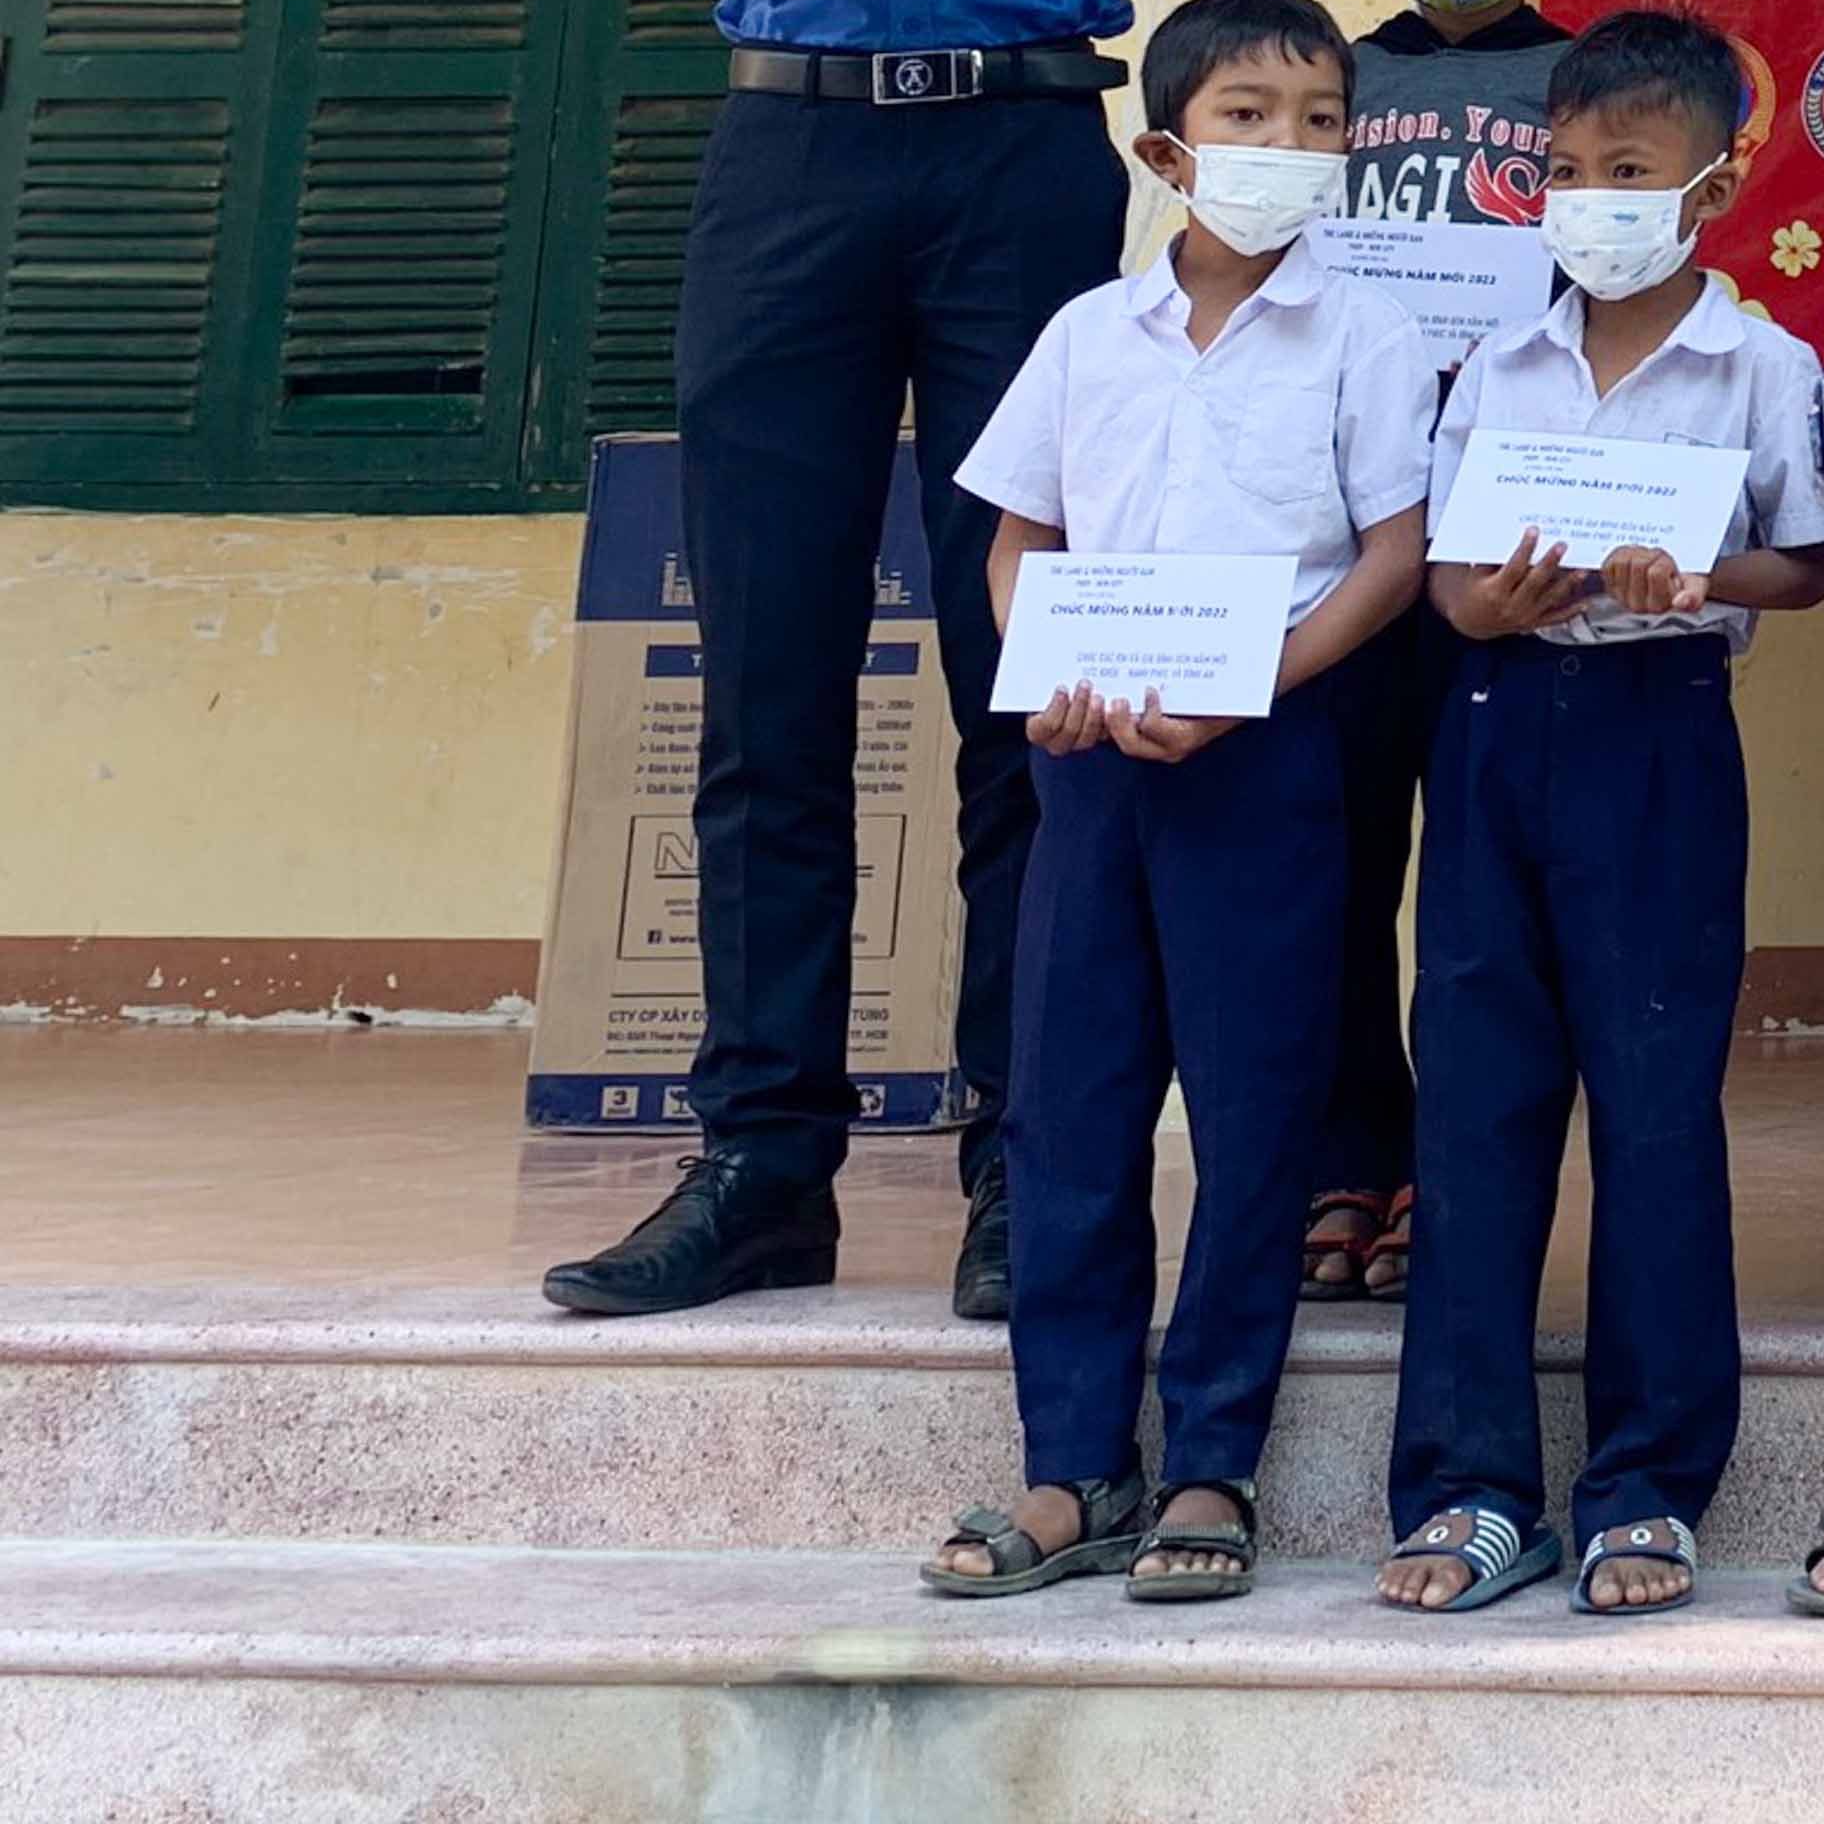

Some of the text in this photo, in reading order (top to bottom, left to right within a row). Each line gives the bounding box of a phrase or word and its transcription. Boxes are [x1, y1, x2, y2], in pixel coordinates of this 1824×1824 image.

[1346, 104, 1551, 156] ision. Your
[1340, 153, 1461, 222] AGI
